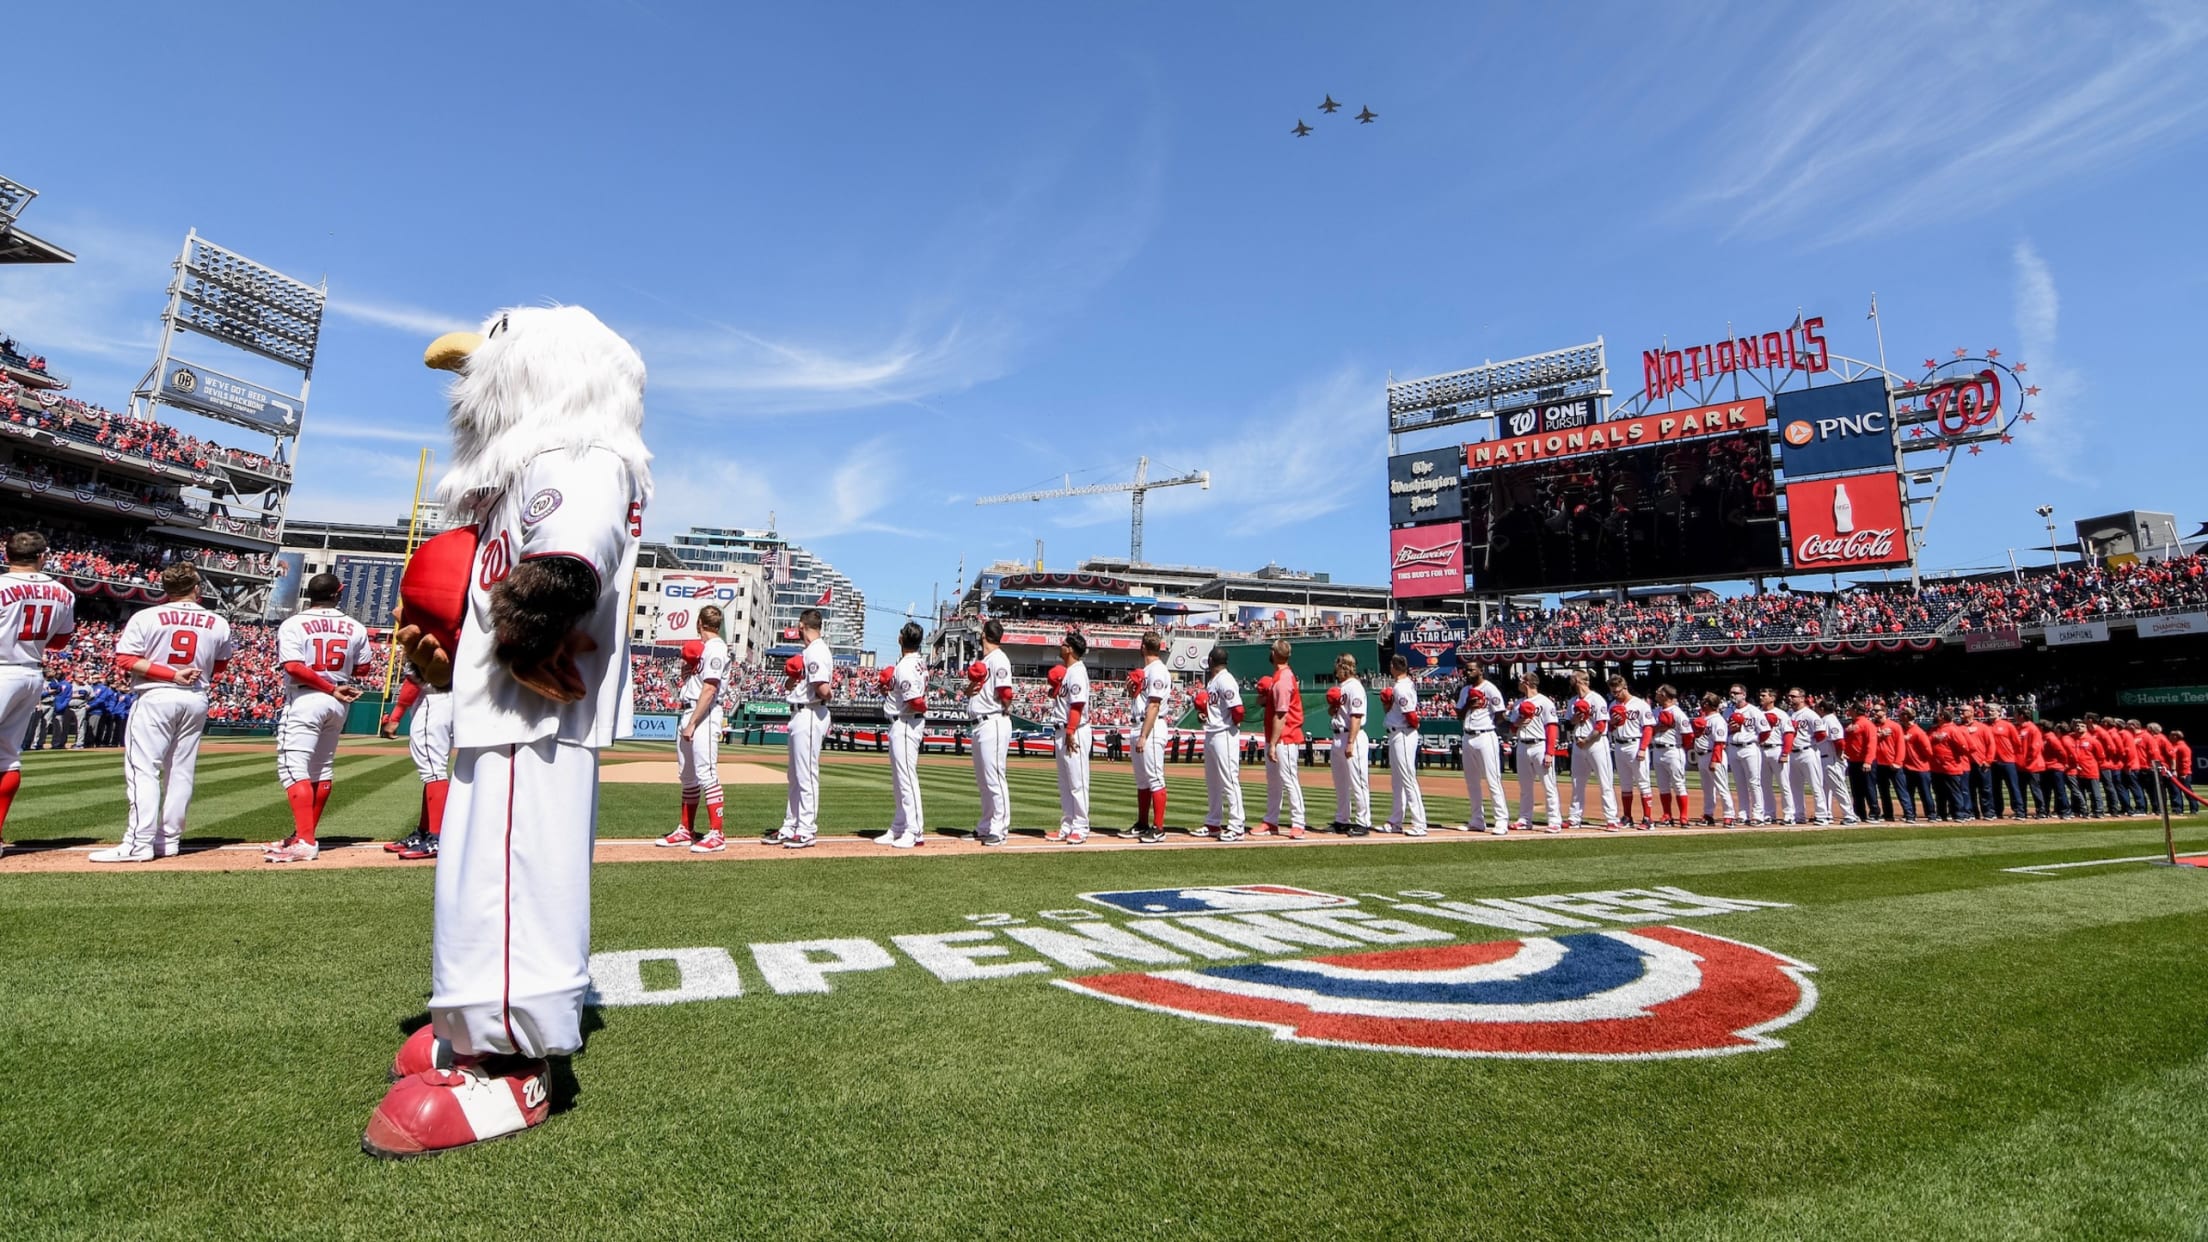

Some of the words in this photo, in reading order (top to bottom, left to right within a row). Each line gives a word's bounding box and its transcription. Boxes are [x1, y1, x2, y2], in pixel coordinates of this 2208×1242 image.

[1642, 316, 1829, 401] NATIONALS
[178, 373, 192, 387] DB
[205, 376, 229, 391] WE'VE
[230, 385, 246, 396] GOT
[203, 386, 228, 400] DEVILS
[229, 394, 265, 411] BACKBONE
[1545, 402, 1588, 421] ONE
[1546, 415, 1588, 431] PURSUIT
[1816, 411, 1885, 440] PNC
[1476, 423, 1644, 463] NATIONALS
[1661, 405, 1748, 434] PARK
[1411, 460, 1434, 475] The
[1391, 476, 1458, 495] Washington
[1410, 494, 1438, 512] Post
[1798, 527, 1897, 563] Coca-Cola
[1397, 548, 1455, 562] Budweiser
[1398, 572, 1411, 580] THIS
[1411, 571, 1430, 579] BUD'S
[18, 604, 54, 641] 11
[158, 611, 216, 630] DOZIER
[301, 618, 355, 636] ROBLES
[2152, 621, 2192, 633] CHAMPIONS
[1399, 631, 1416, 644] ALL
[1416, 631, 1440, 643] STAR
[1441, 630, 1467, 642] GAME
[2059, 629, 2094, 642] CHAMPIONS
[167, 629, 199, 665] 9
[311, 638, 349, 672] 16
[2137, 692, 2178, 704] Harris
[588, 908, 1458, 1007] OPENING
[1391, 886, 1795, 933] WEEK
